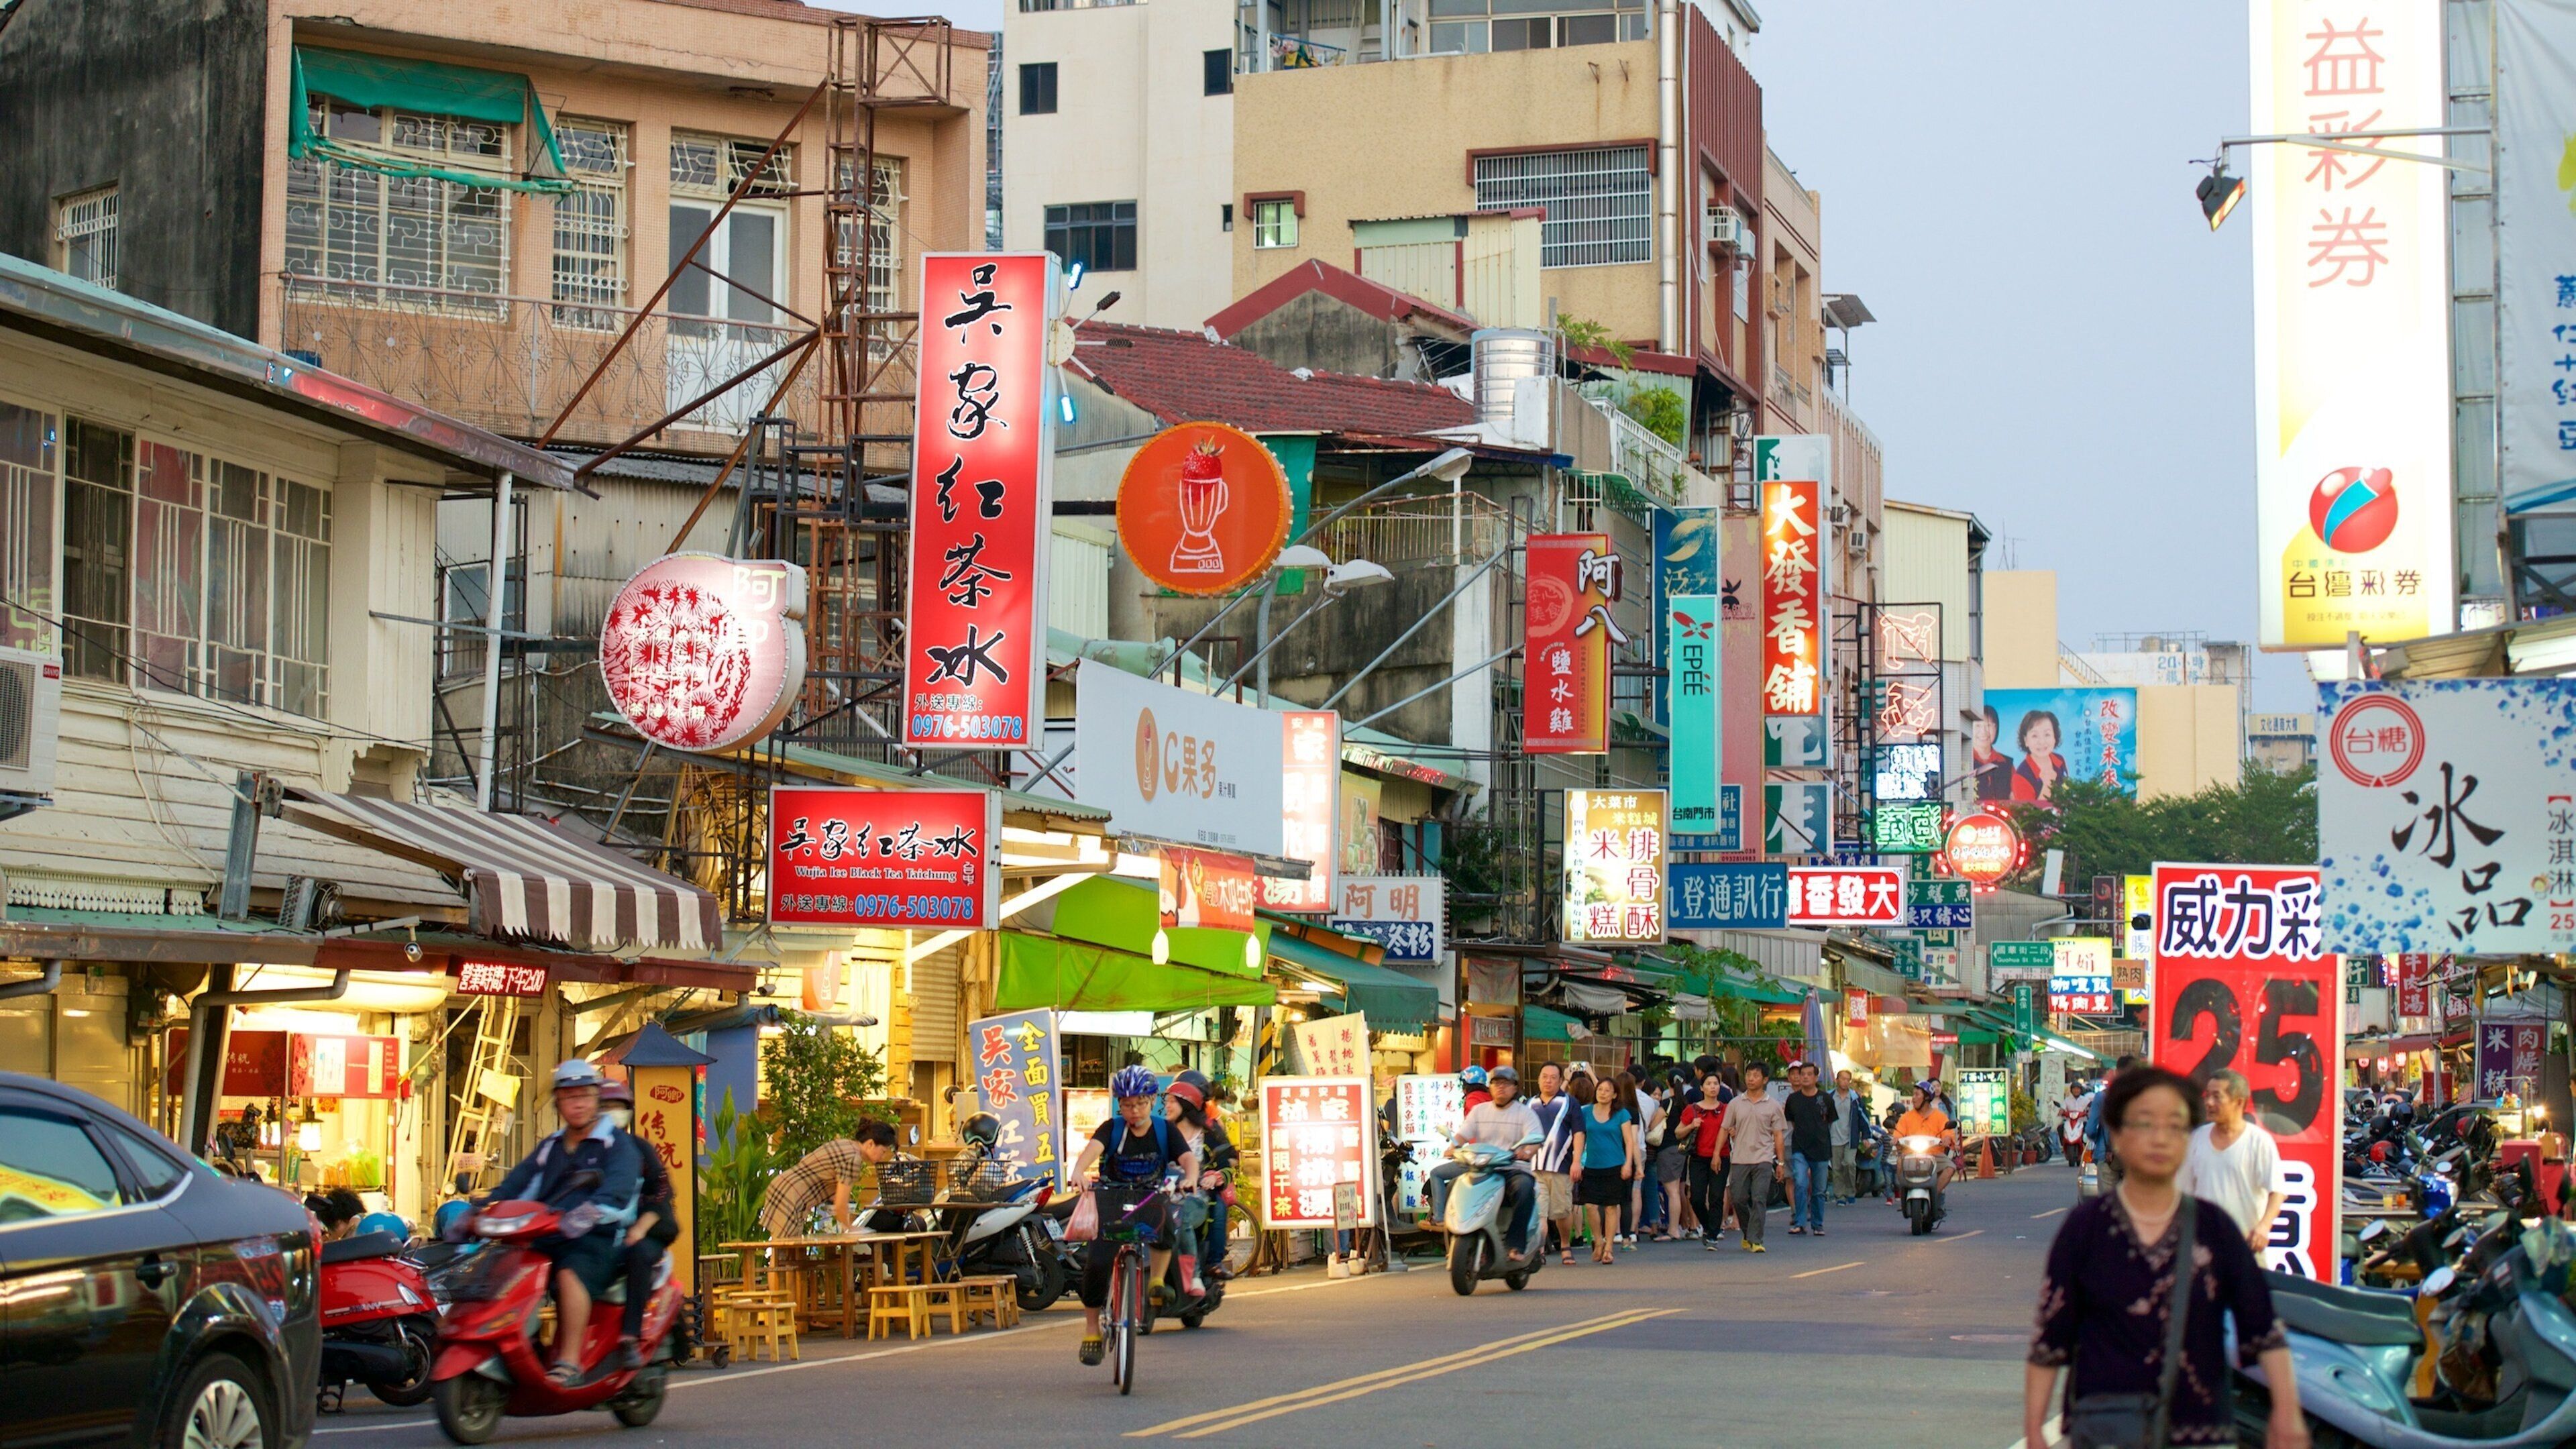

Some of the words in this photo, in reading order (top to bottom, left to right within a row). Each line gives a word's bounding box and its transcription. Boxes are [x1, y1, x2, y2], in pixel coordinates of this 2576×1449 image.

[1574, 549, 1629, 644] 阿八
[2289, 570, 2421, 598] 台灣彩券
[1765, 484, 1817, 713] 大發香舖
[1549, 649, 1574, 733] 鹽水雞
[912, 715, 1023, 739] 0976-503078
[2346, 726, 2407, 753] 台糖
[1672, 806, 1715, 820] 台南門市
[779, 816, 979, 861] 吳家紅茶冰
[2391, 761, 2533, 939] 冰品
[795, 865, 826, 879] Wujia
[828, 866, 847, 879] Ice
[849, 867, 881, 879] Black
[883, 869, 903, 880] Tea
[905, 867, 957, 881] Taichung
[855, 894, 974, 920] 0976-503078
[1345, 883, 1420, 922] 阿明
[2551, 914, 2575, 930] 25
